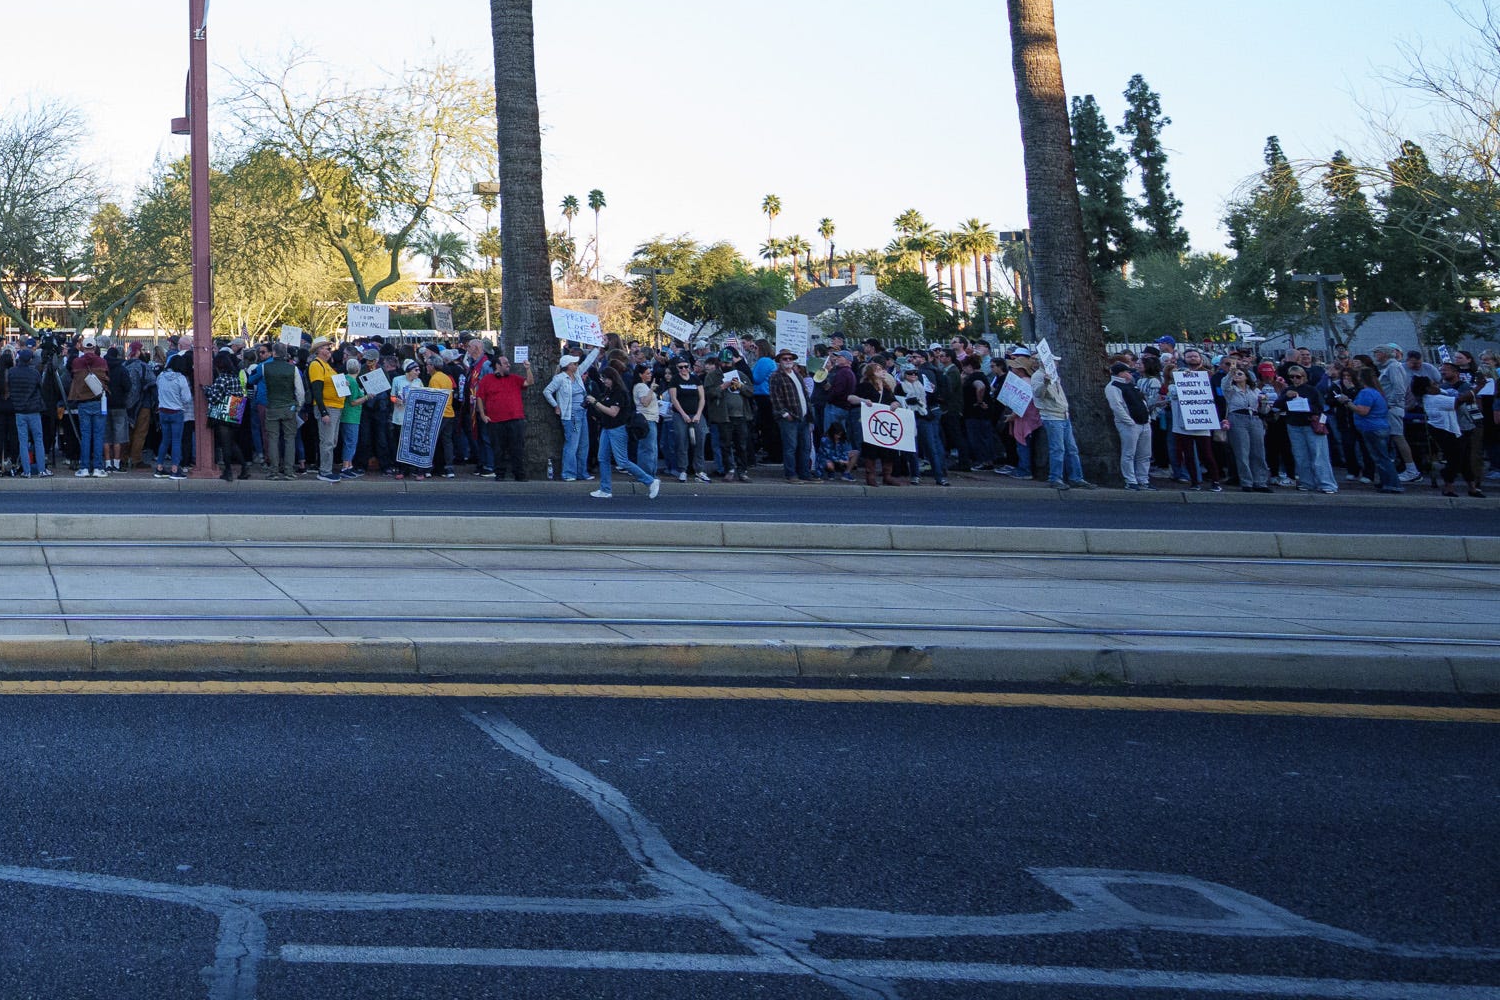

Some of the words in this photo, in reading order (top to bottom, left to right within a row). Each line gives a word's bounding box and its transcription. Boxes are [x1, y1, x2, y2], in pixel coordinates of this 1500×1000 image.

[352, 305, 381, 314] MURDER
[351, 321, 368, 329] EVERY
[872, 418, 899, 439] ICE
